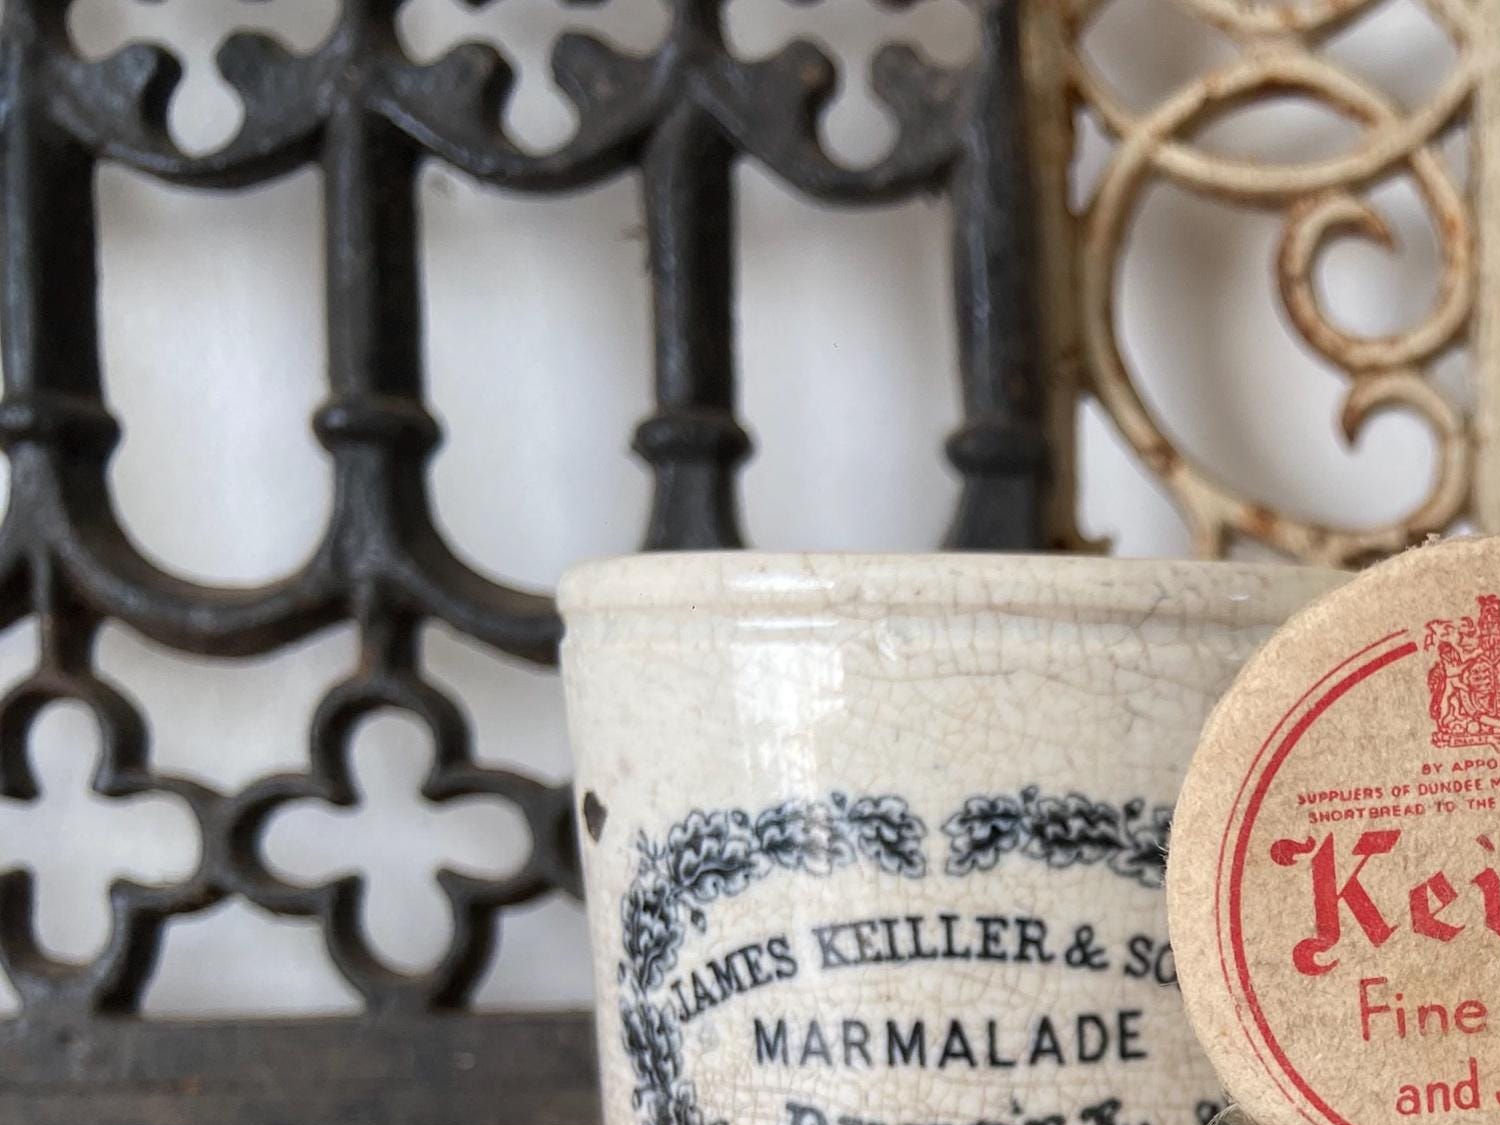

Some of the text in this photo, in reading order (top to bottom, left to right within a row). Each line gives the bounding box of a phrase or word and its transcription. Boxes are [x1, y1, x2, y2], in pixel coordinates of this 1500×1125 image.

[1297, 786, 1384, 806] SUPPLIERS
[1391, 784, 1411, 798] OF
[1418, 779, 1483, 796] DUNDEE
[1421, 762, 1443, 775] BY
[1307, 803, 1426, 824] SHORTBREAD
[1435, 800, 1457, 813] TO
[1467, 797, 1496, 809] THE
[670, 935, 798, 1023] JAMES
[812, 914, 1055, 969] KEILLER
[1065, 926, 1110, 971] &
[1360, 976, 1488, 1042] Fine
[754, 1010, 1149, 1068] MARMALADE
[1396, 1056, 1481, 1116] and
